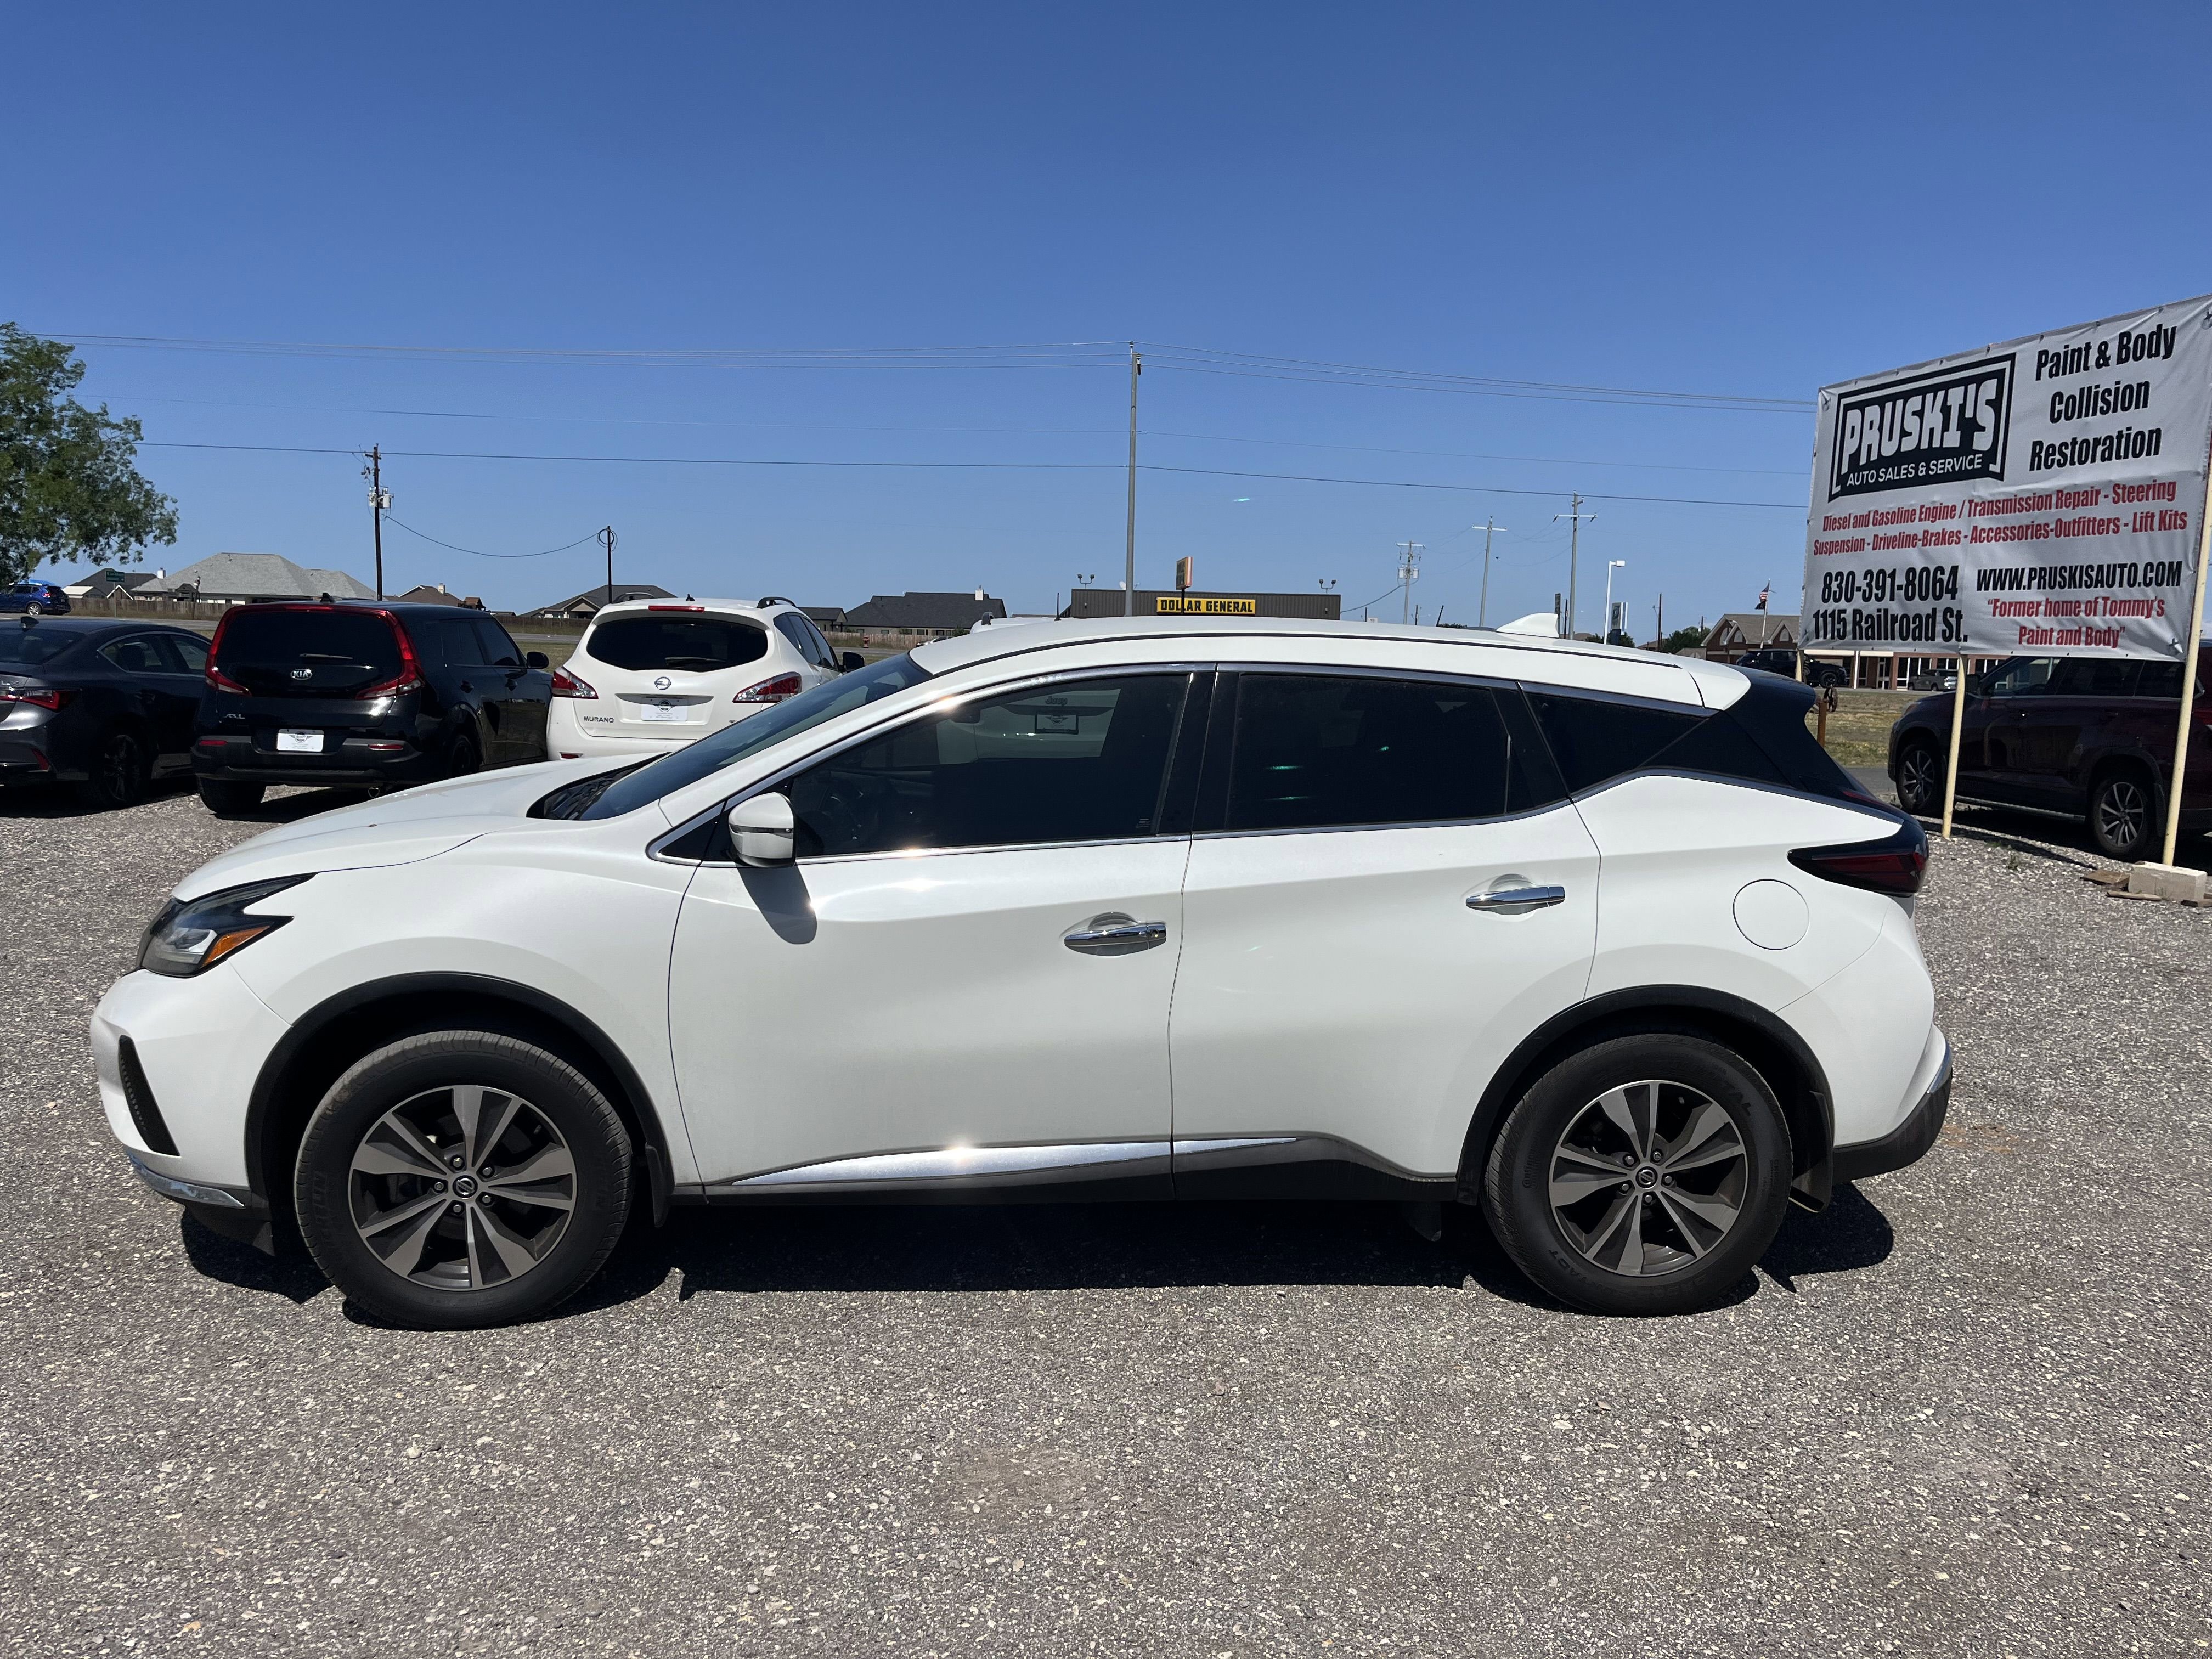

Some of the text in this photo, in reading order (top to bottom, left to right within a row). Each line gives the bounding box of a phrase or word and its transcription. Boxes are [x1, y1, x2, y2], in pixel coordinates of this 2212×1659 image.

[2035, 324, 2177, 381] Paint & Body
[2050, 381, 2150, 424] Collision
[1841, 379, 1997, 475] PRUSKI'S
[2029, 426, 2162, 471] Restoration
[1847, 454, 1983, 487] AUTO SALES & SERVICE
[1822, 512, 1852, 532] Diesel
[1853, 511, 1871, 529] and
[1872, 507, 1916, 527] Gasoline
[1918, 503, 1957, 523] Engine
[1959, 500, 1966, 519] /
[1967, 493, 2052, 517] Transmission
[2055, 486, 2101, 510] Repair
[2112, 479, 2177, 504] Steering
[1814, 536, 1865, 556] Suspension
[1872, 528, 1961, 551] Driveline-Brakes
[1970, 516, 2121, 544] Accessories-Outfitters
[2132, 511, 2155, 533] Lift
[2158, 510, 2188, 531] Kits
[1821, 565, 1959, 603] 830-391-8064
[1977, 561, 2182, 591] WWW.PRUSKISAUTO.COM
[1161, 599, 1252, 612] DOLAR GENERAL
[1813, 607, 1968, 642] 1115 Railroad St.
[2044, 597, 2081, 617] home
[2085, 597, 2098, 617] of
[2019, 626, 2054, 645] Paint
[2057, 626, 2082, 646] and
